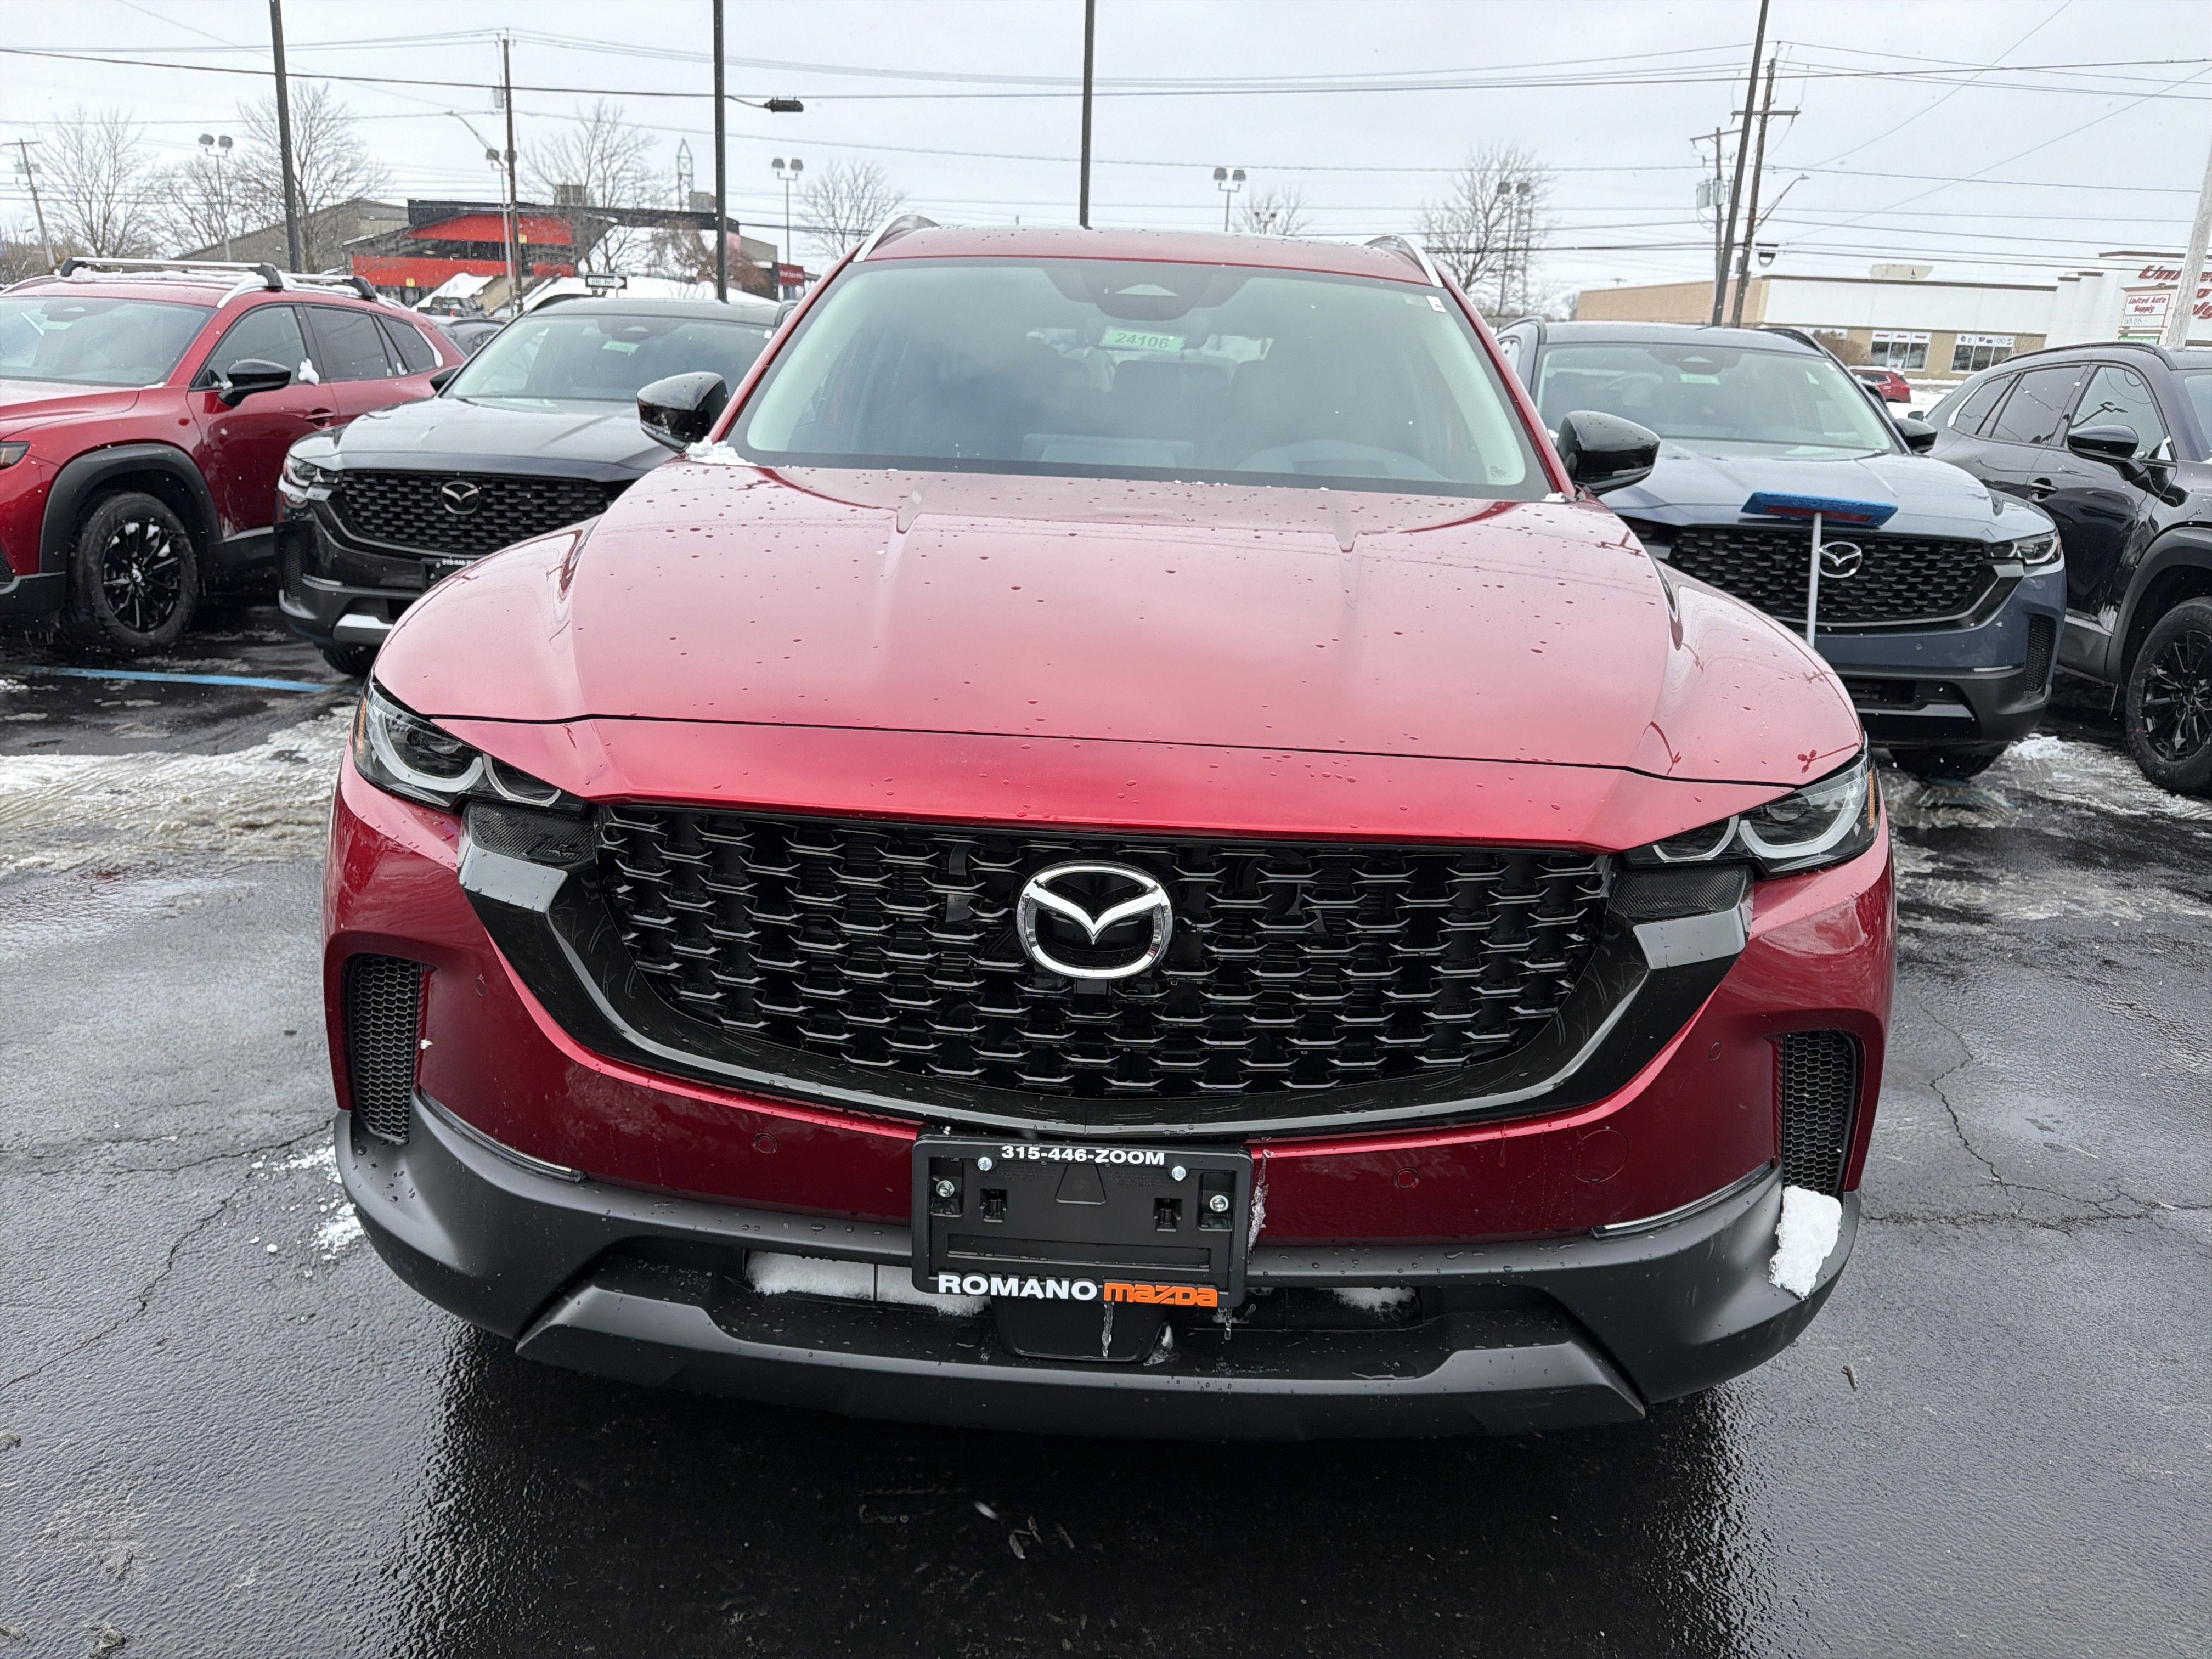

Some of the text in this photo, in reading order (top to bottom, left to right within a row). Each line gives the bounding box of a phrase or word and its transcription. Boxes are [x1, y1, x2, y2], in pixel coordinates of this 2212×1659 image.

[2133, 304, 2155, 313] Supply
[1114, 332, 1170, 348] 24106
[1001, 1146, 1165, 1165] 315-446-ZOOM
[938, 1274, 1218, 1308] ROMANO mazda
